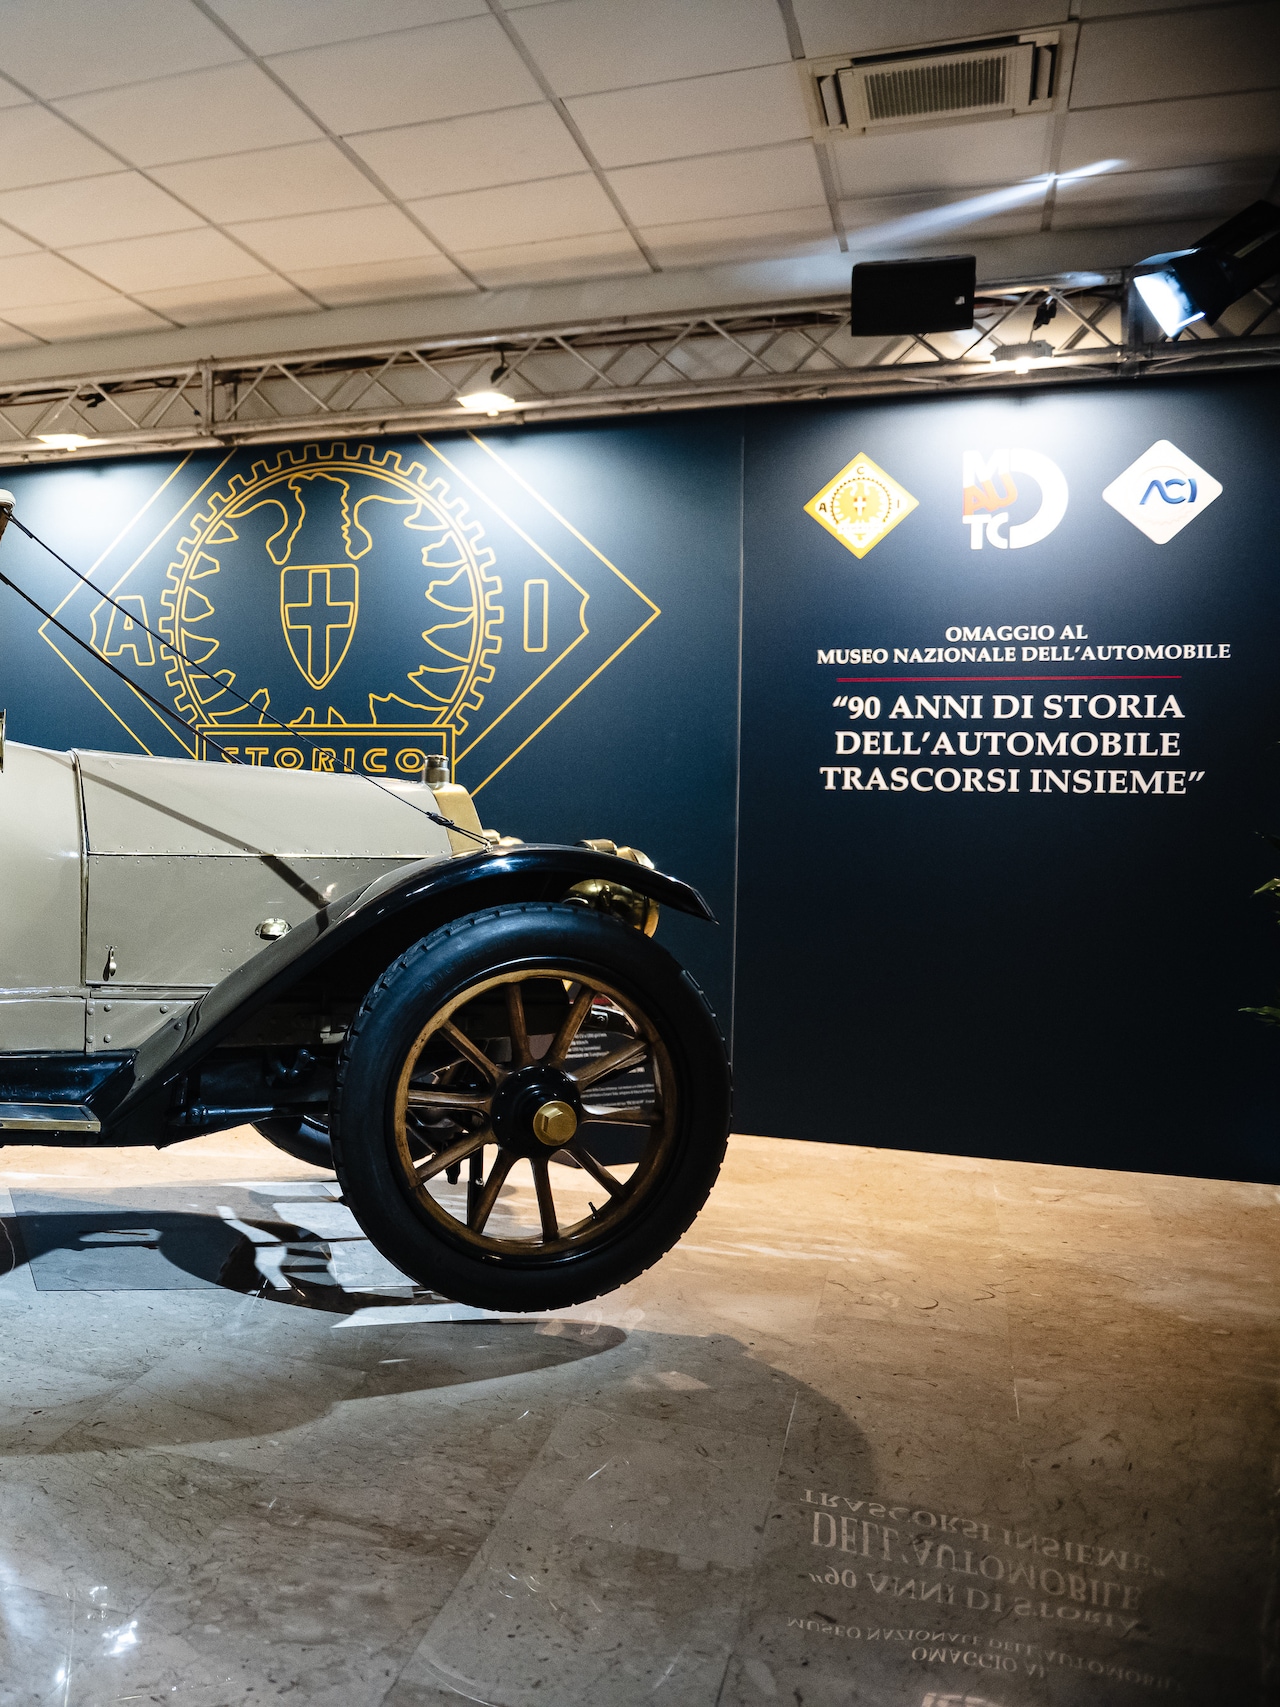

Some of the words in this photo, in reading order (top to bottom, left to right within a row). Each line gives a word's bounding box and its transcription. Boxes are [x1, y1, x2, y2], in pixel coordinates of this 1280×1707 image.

[1139, 478, 1198, 505] ACI
[945, 626, 1055, 642] OMAGGIO
[1060, 625, 1088, 640] AL
[817, 649, 889, 665] MUSEO
[894, 647, 1016, 664] NAZIONALE
[1022, 644, 1231, 662] DELL'AUTOMOBILE
[832, 695, 881, 720] "90
[889, 695, 983, 720] ANNI
[992, 695, 1034, 719] DI
[1044, 695, 1185, 720] STORIA
[835, 731, 1181, 757] DELL'AUTOMOBILE
[820, 766, 1020, 793] TRASCORSI
[1030, 769, 1206, 795] INSIEME"
